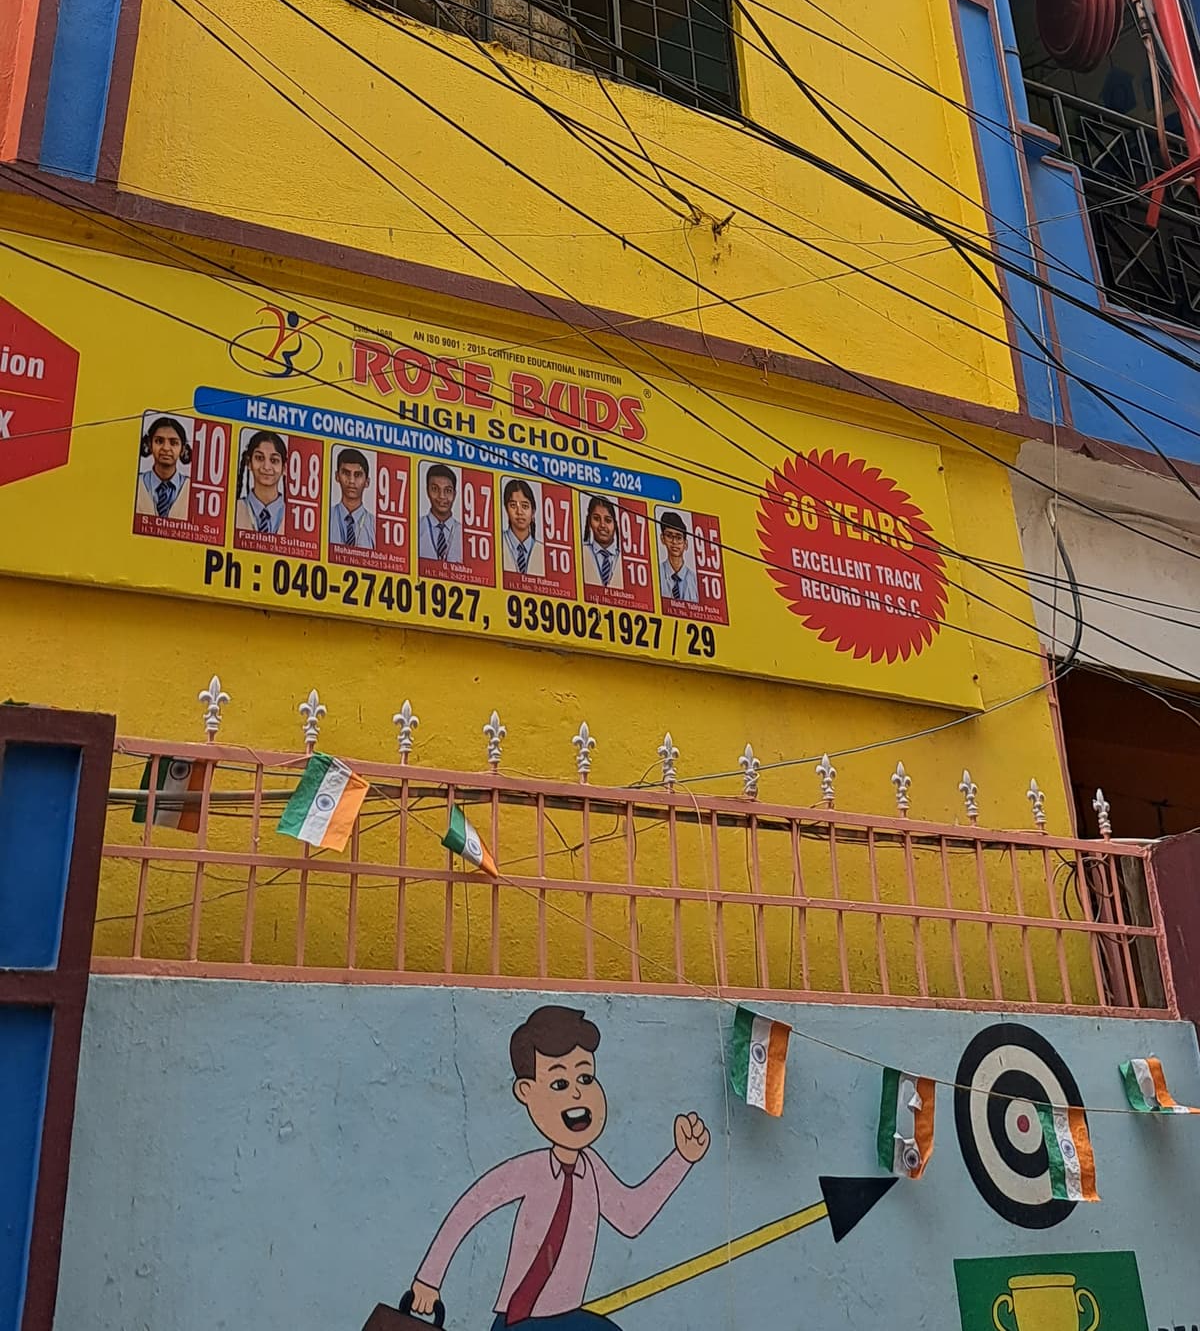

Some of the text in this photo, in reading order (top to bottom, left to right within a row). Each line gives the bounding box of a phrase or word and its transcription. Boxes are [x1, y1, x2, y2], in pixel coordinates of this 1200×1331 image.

[414, 331, 424, 341] AN
[427, 336, 439, 344] ISO
[442, 338, 459, 348] 9001
[468, 343, 485, 354] 2015
[488, 348, 525, 364] CERTIFIED
[528, 357, 576, 375] EDUCATIONAL
[578, 368, 621, 385] INSTITUTION
[352, 338, 646, 443] ROSE BUDS
[246, 400, 307, 427] HEARTY
[312, 412, 452, 454] CONGRATULATIONS
[456, 441, 475, 460] TO
[479, 444, 509, 466] OUR
[512, 450, 538, 471] SSC
[542, 457, 600, 484] TOPPERS
[612, 471, 642, 492] 2024
[399, 400, 608, 460] HIGH SCHOOL
[194, 424, 225, 485] 10
[288, 450, 320, 499] 9.8
[196, 491, 220, 516] 10
[378, 467, 407, 514] 9.7
[464, 482, 490, 528] 9.7
[142, 516, 220, 534] S. Charitha Sai
[239, 531, 318, 549] Fazilath Sultana
[292, 506, 316, 532] 10
[383, 523, 405, 546] 10
[544, 498, 570, 542] 9.7
[621, 511, 646, 556] 9.7
[783, 492, 914, 551] 36 YEARS
[334, 545, 369, 557] Mohammed
[371, 551, 388, 560] Abdul
[468, 536, 489, 560] 10
[549, 550, 570, 574] 10
[696, 526, 720, 570] 9.5
[792, 548, 923, 591] EXCELLENT TRACK
[537, 578, 559, 587] Rahman
[627, 564, 647, 587] 10
[702, 576, 722, 600] 10
[801, 578, 861, 607] RECORD
[864, 590, 880, 611] IN
[205, 549, 241, 590] Ph
[272, 560, 489, 630] 040-27401927,
[507, 596, 662, 650] 9390021927
[686, 624, 716, 658] 29
